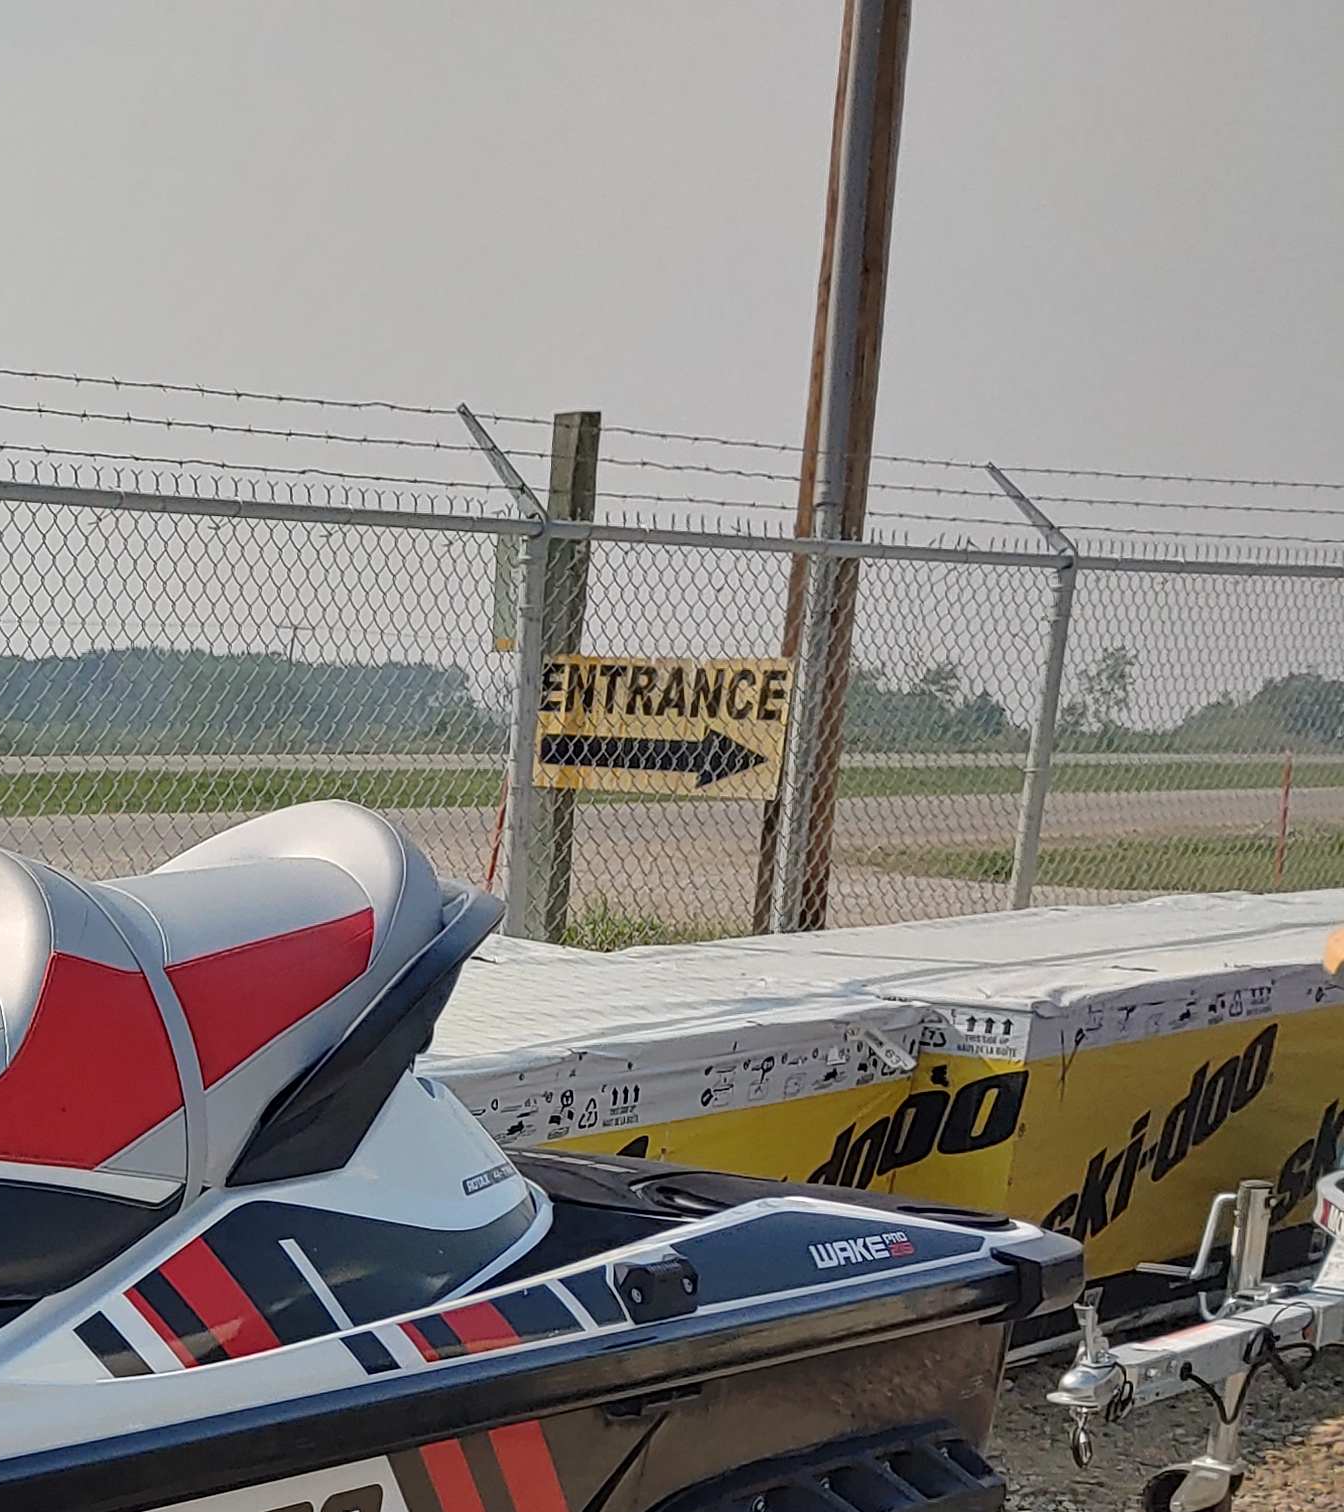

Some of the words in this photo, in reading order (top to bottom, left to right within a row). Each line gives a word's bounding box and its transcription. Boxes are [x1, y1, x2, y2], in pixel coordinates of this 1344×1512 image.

[538, 662, 788, 721] ENTRANCE
[808, 1235, 891, 1269] WAKE
[882, 1231, 909, 1245] PRO
